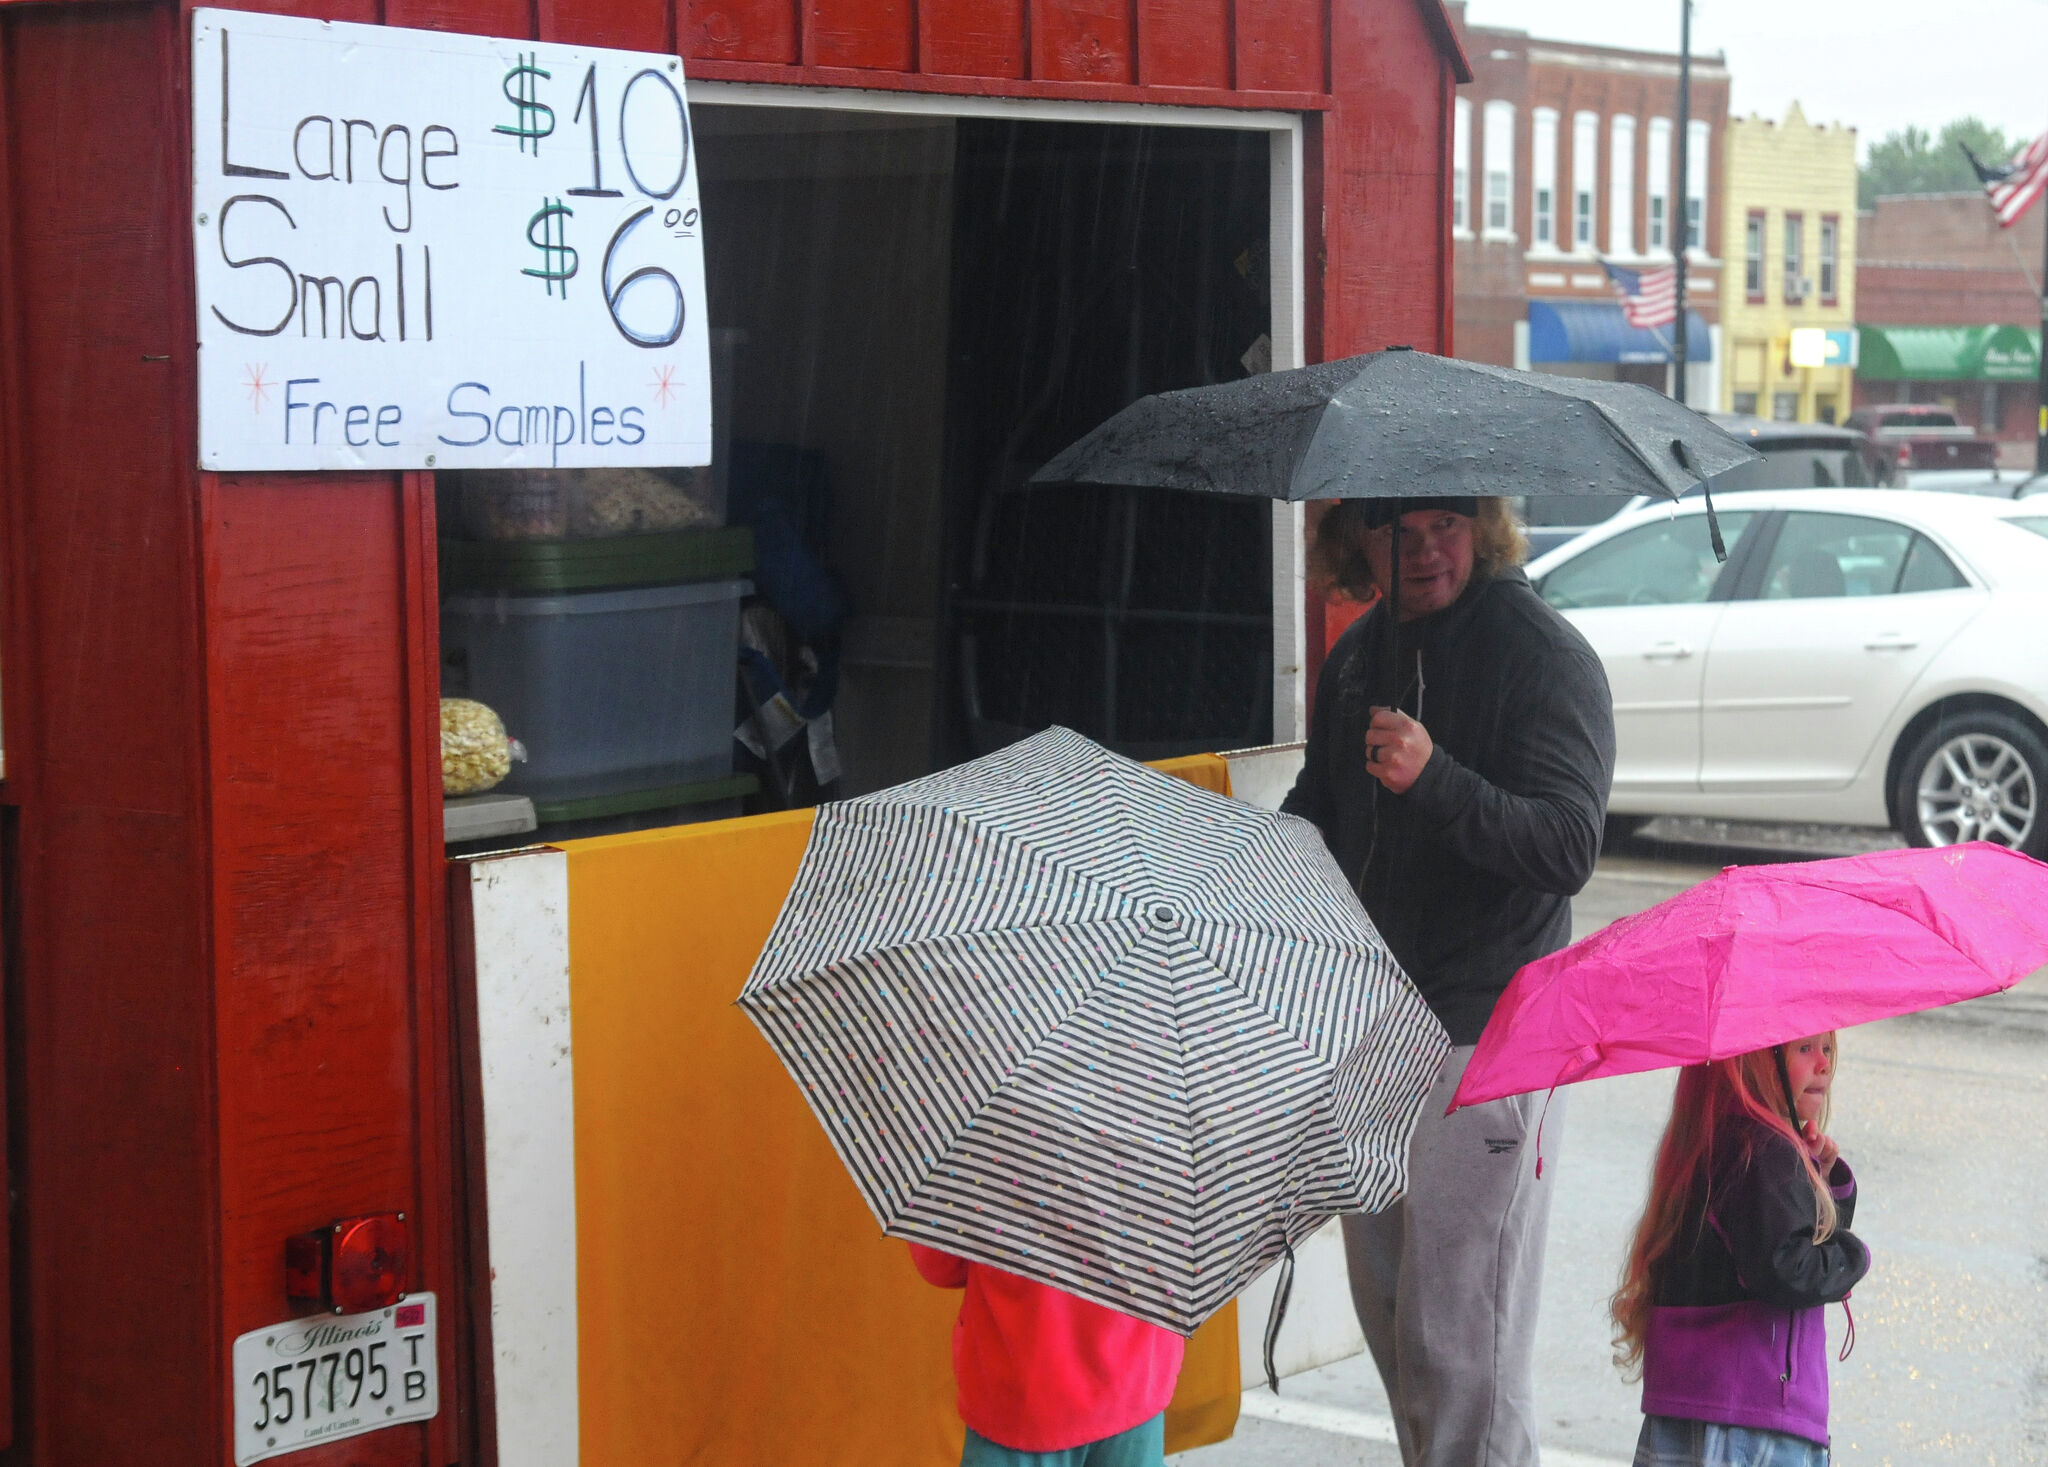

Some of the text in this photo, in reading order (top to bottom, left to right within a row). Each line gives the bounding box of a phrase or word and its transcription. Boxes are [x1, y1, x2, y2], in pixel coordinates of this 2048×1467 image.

[221, 28, 689, 233] Large $10
[211, 194, 433, 342] Small
[284, 360, 646, 467] Free Samples
[252, 1341, 388, 1431] 357795
[275, 1320, 383, 1357] Illinois
